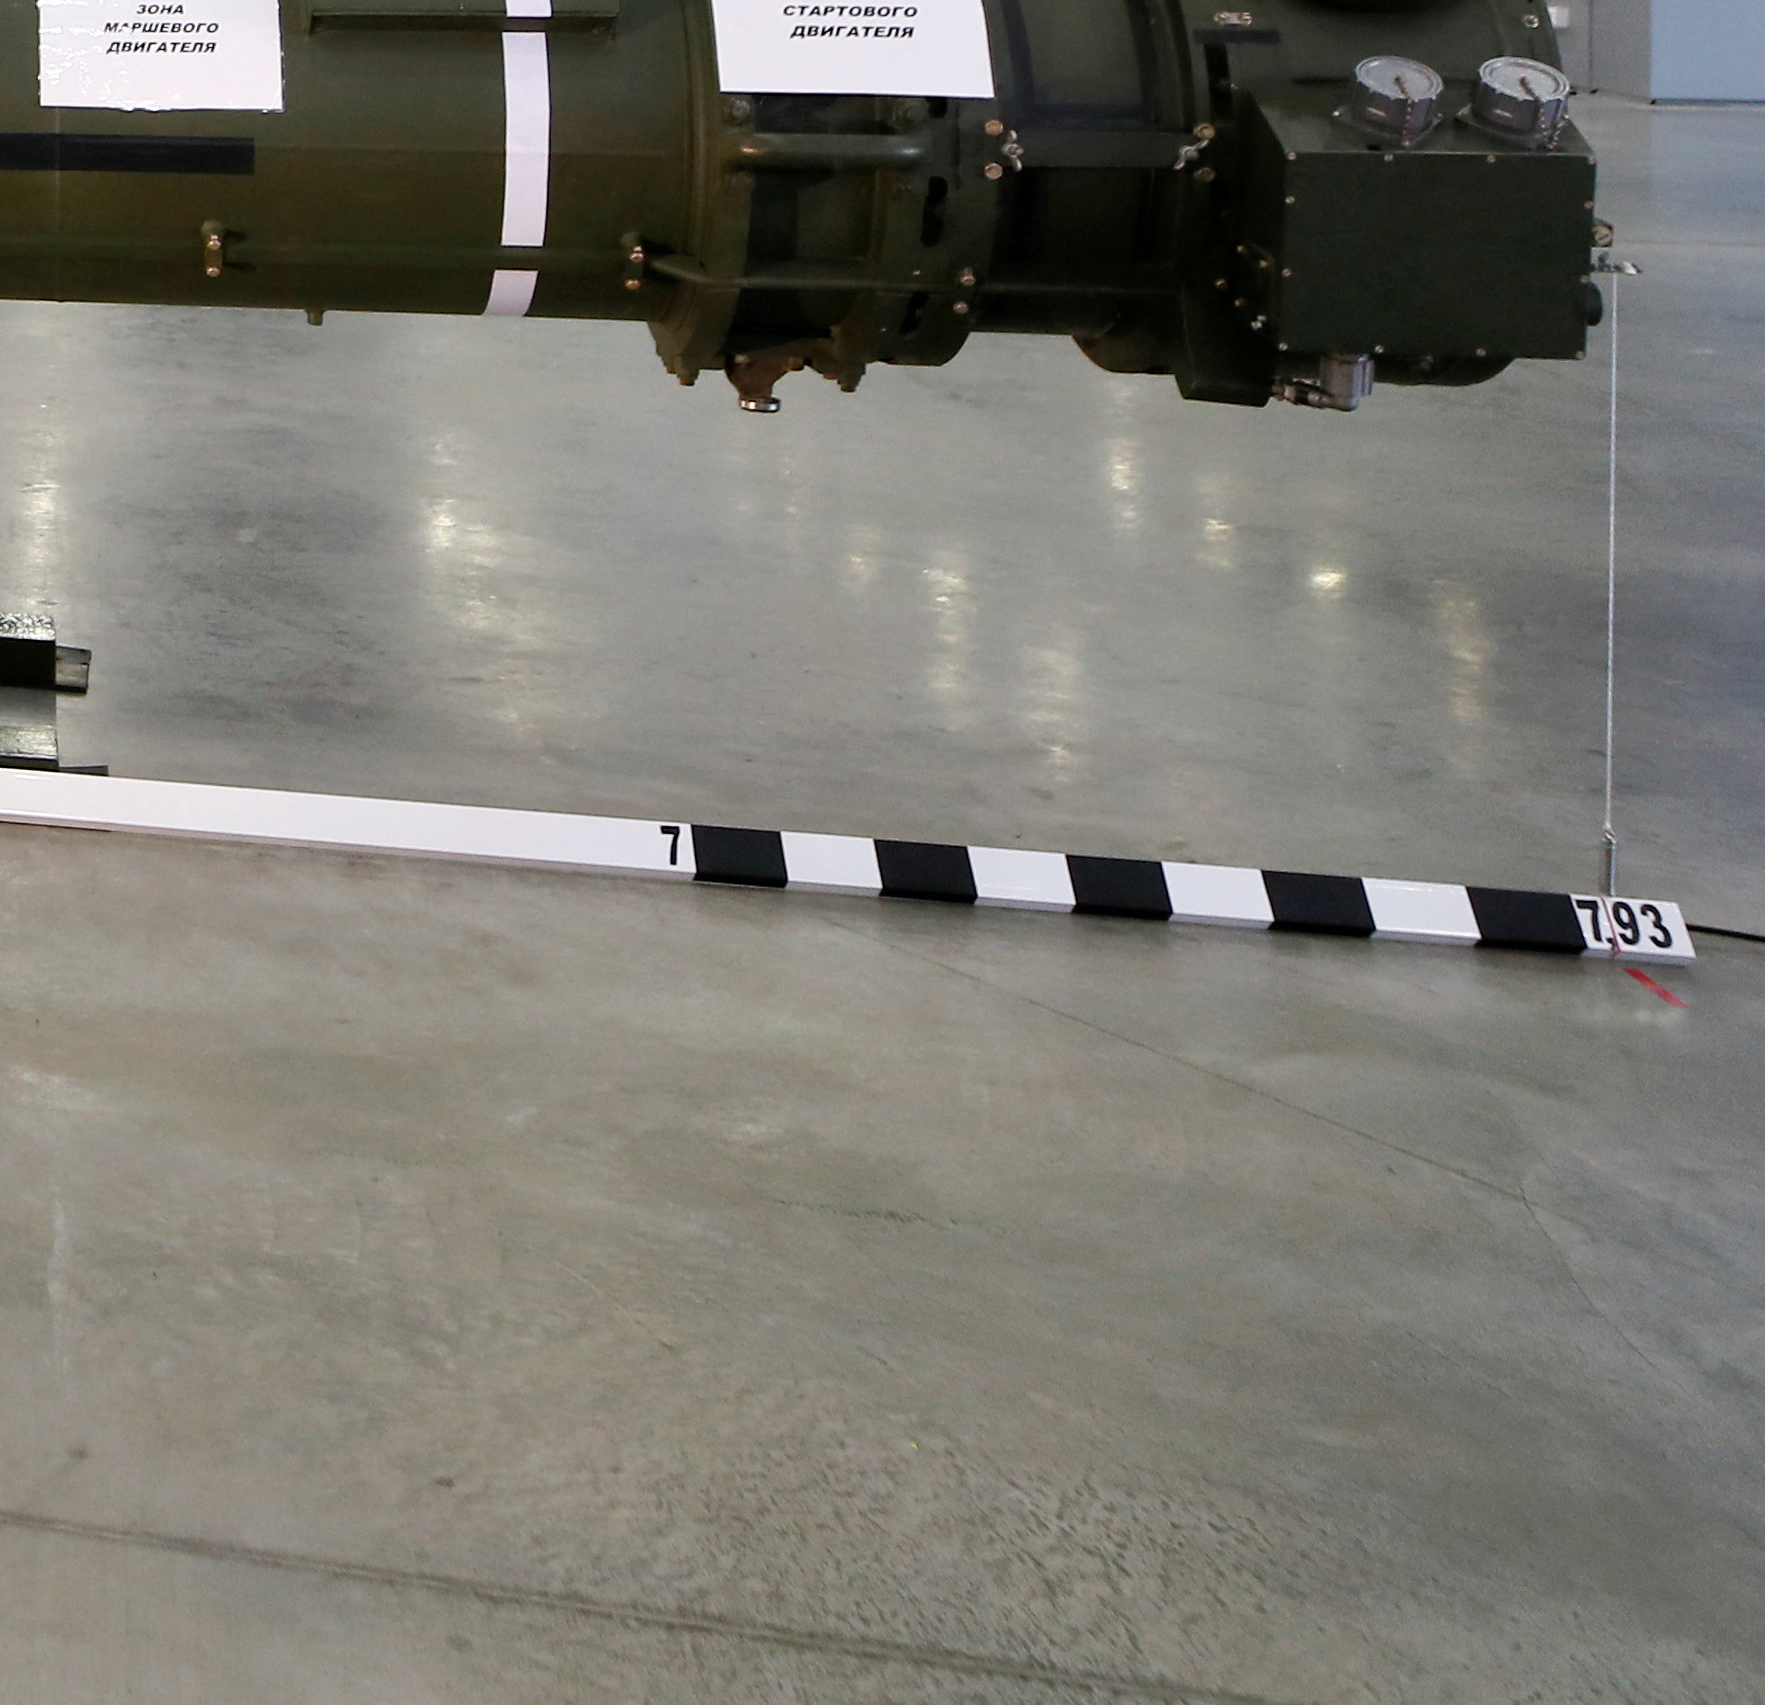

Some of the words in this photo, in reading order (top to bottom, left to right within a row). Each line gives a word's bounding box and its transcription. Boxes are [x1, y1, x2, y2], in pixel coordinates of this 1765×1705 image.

[136, 4, 184, 15] ЗОНА
[782, 4, 919, 18] СТАРТОВОГО
[103, 22, 220, 34] МАРШЕВОГО
[789, 25, 915, 40] ДВИГАТЕЛЯ
[105, 41, 217, 55] ДВИГАТЕЛЯ
[660, 825, 679, 865] 7
